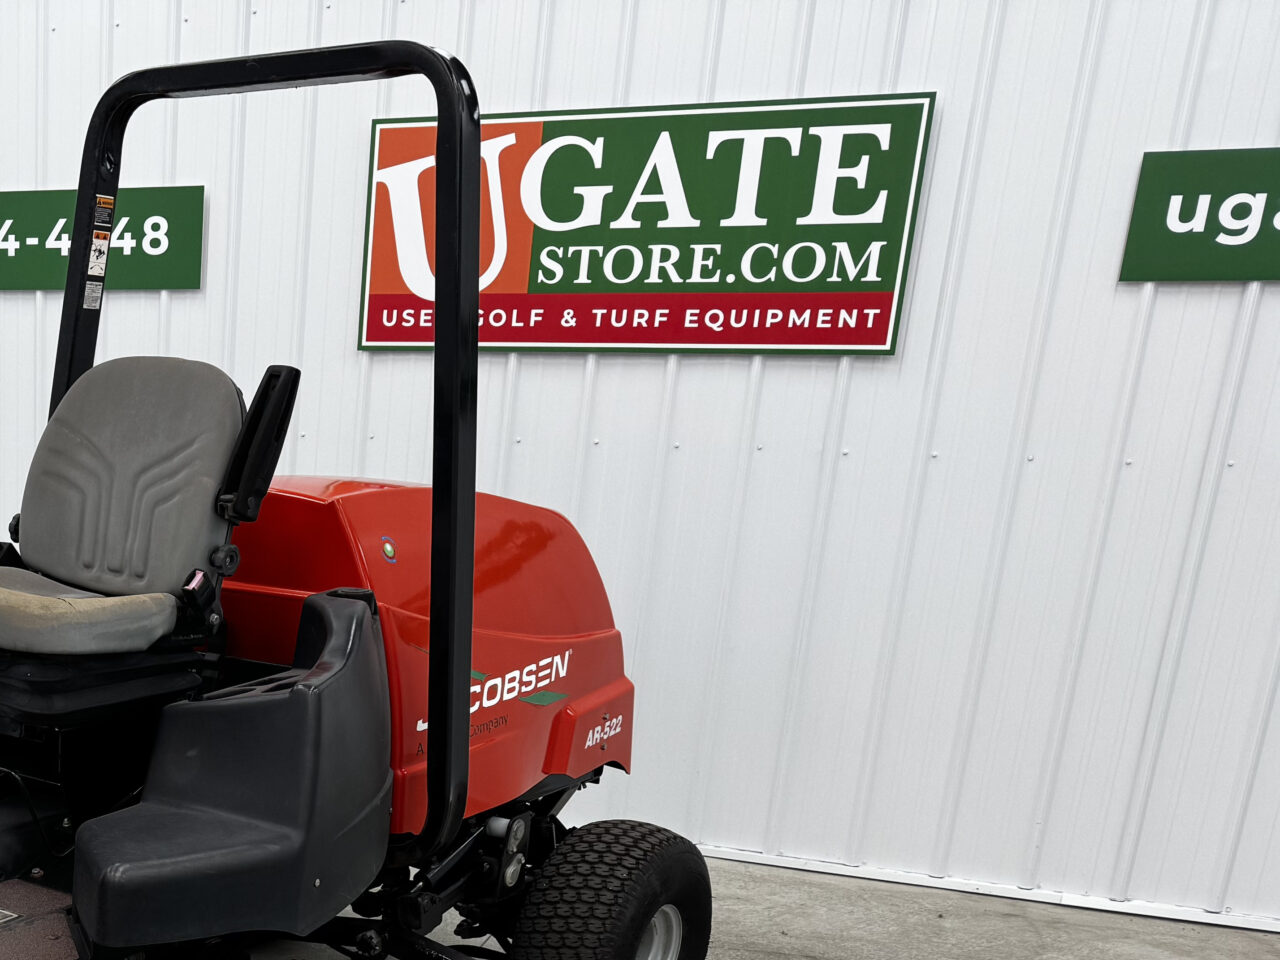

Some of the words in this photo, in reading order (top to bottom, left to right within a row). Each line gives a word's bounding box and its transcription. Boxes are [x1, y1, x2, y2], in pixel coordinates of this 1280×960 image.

[1166, 192, 1280, 246] ug
[537, 241, 888, 285] STORE.COM
[382, 309, 434, 327] USE
[560, 308, 577, 327] &
[592, 309, 670, 328] TURF
[684, 308, 881, 332] EQUIPMENT
[417, 650, 570, 732] COBSEN
[584, 714, 623, 749] AR-522
